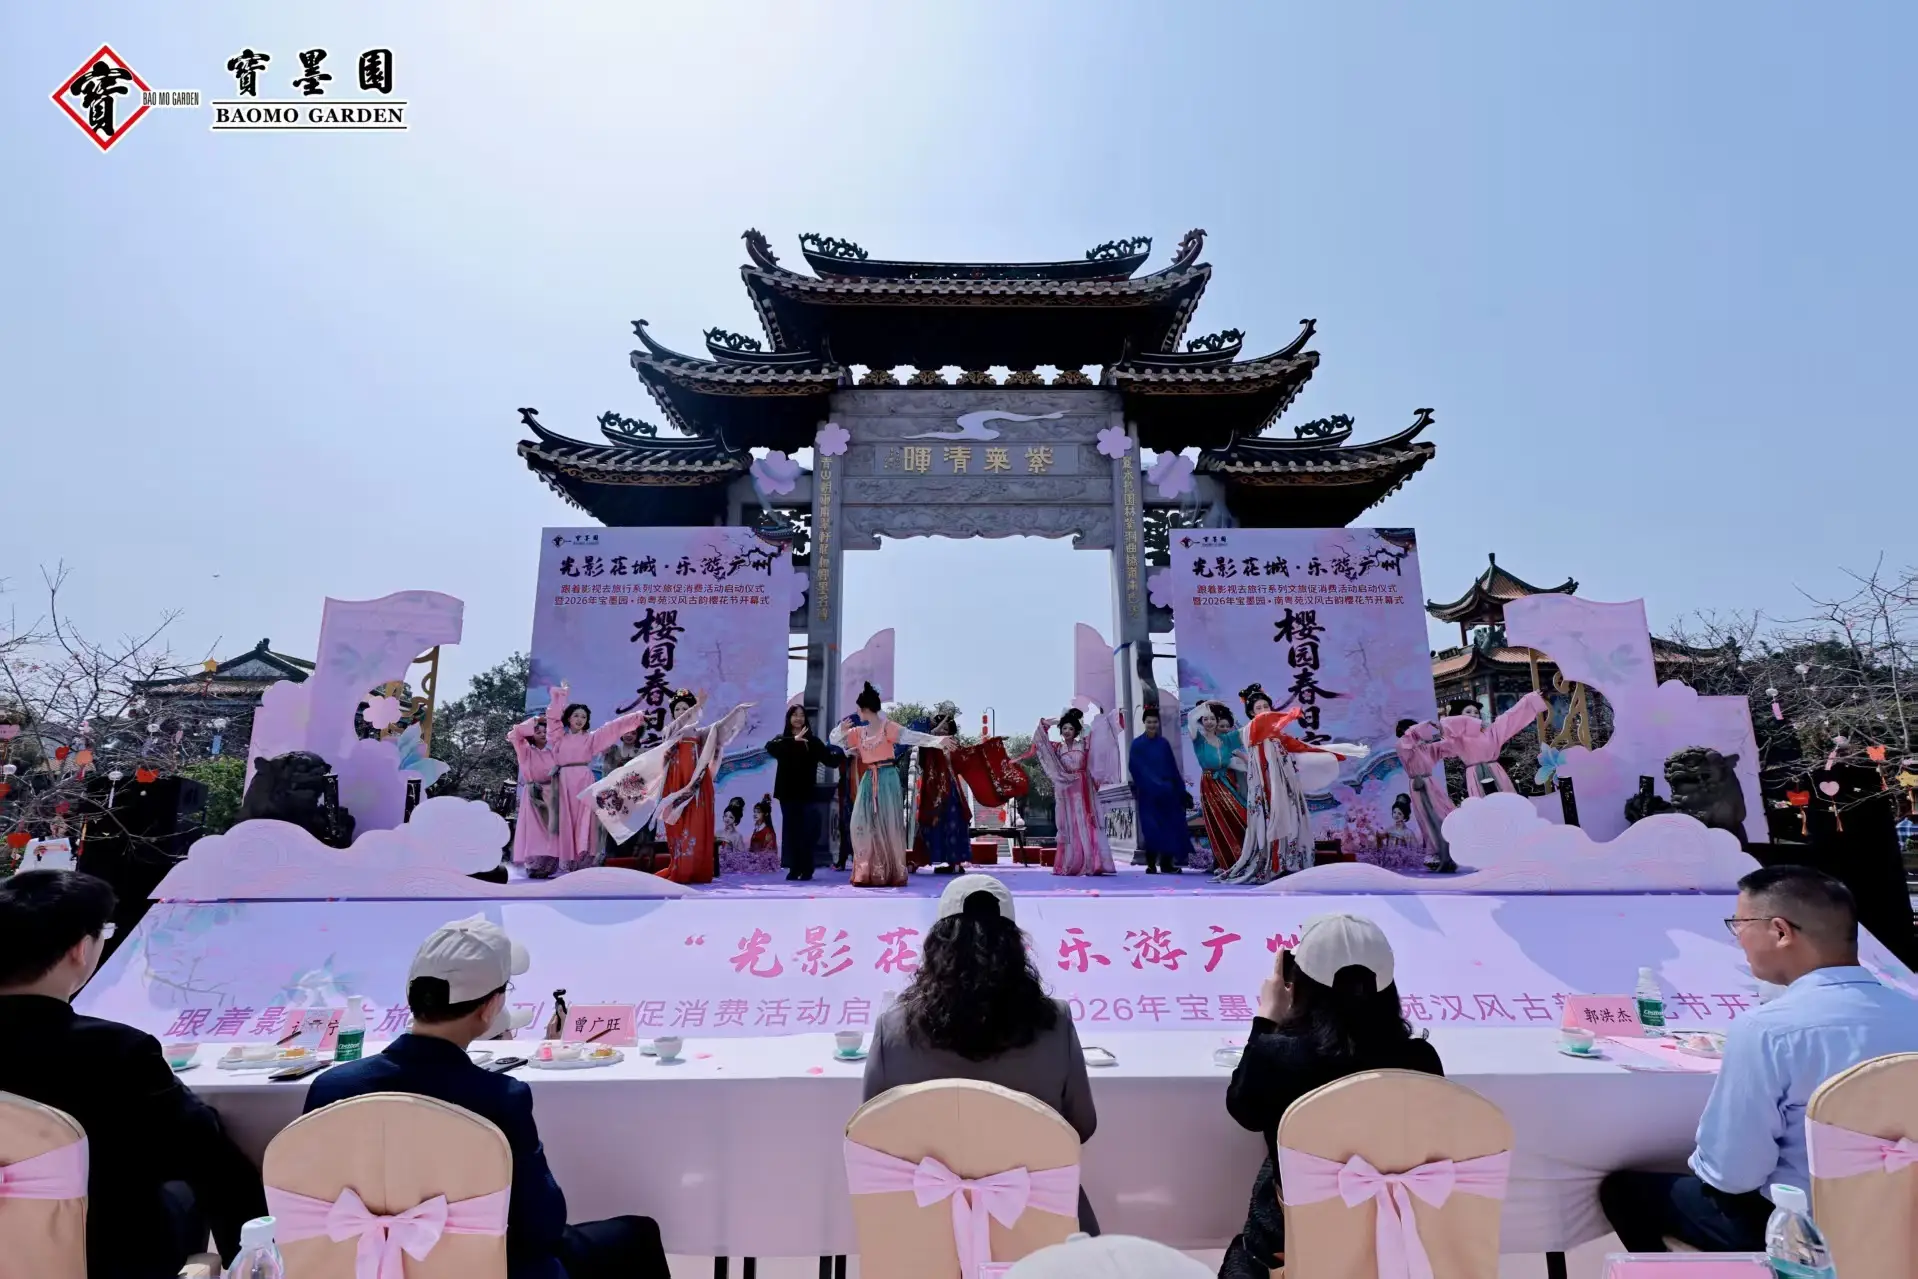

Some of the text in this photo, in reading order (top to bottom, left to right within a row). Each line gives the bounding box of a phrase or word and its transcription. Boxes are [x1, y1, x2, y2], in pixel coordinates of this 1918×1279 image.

[575, 1016, 622, 1033] 曾广旺
[1583, 1007, 1633, 1025] 郭洪杰
